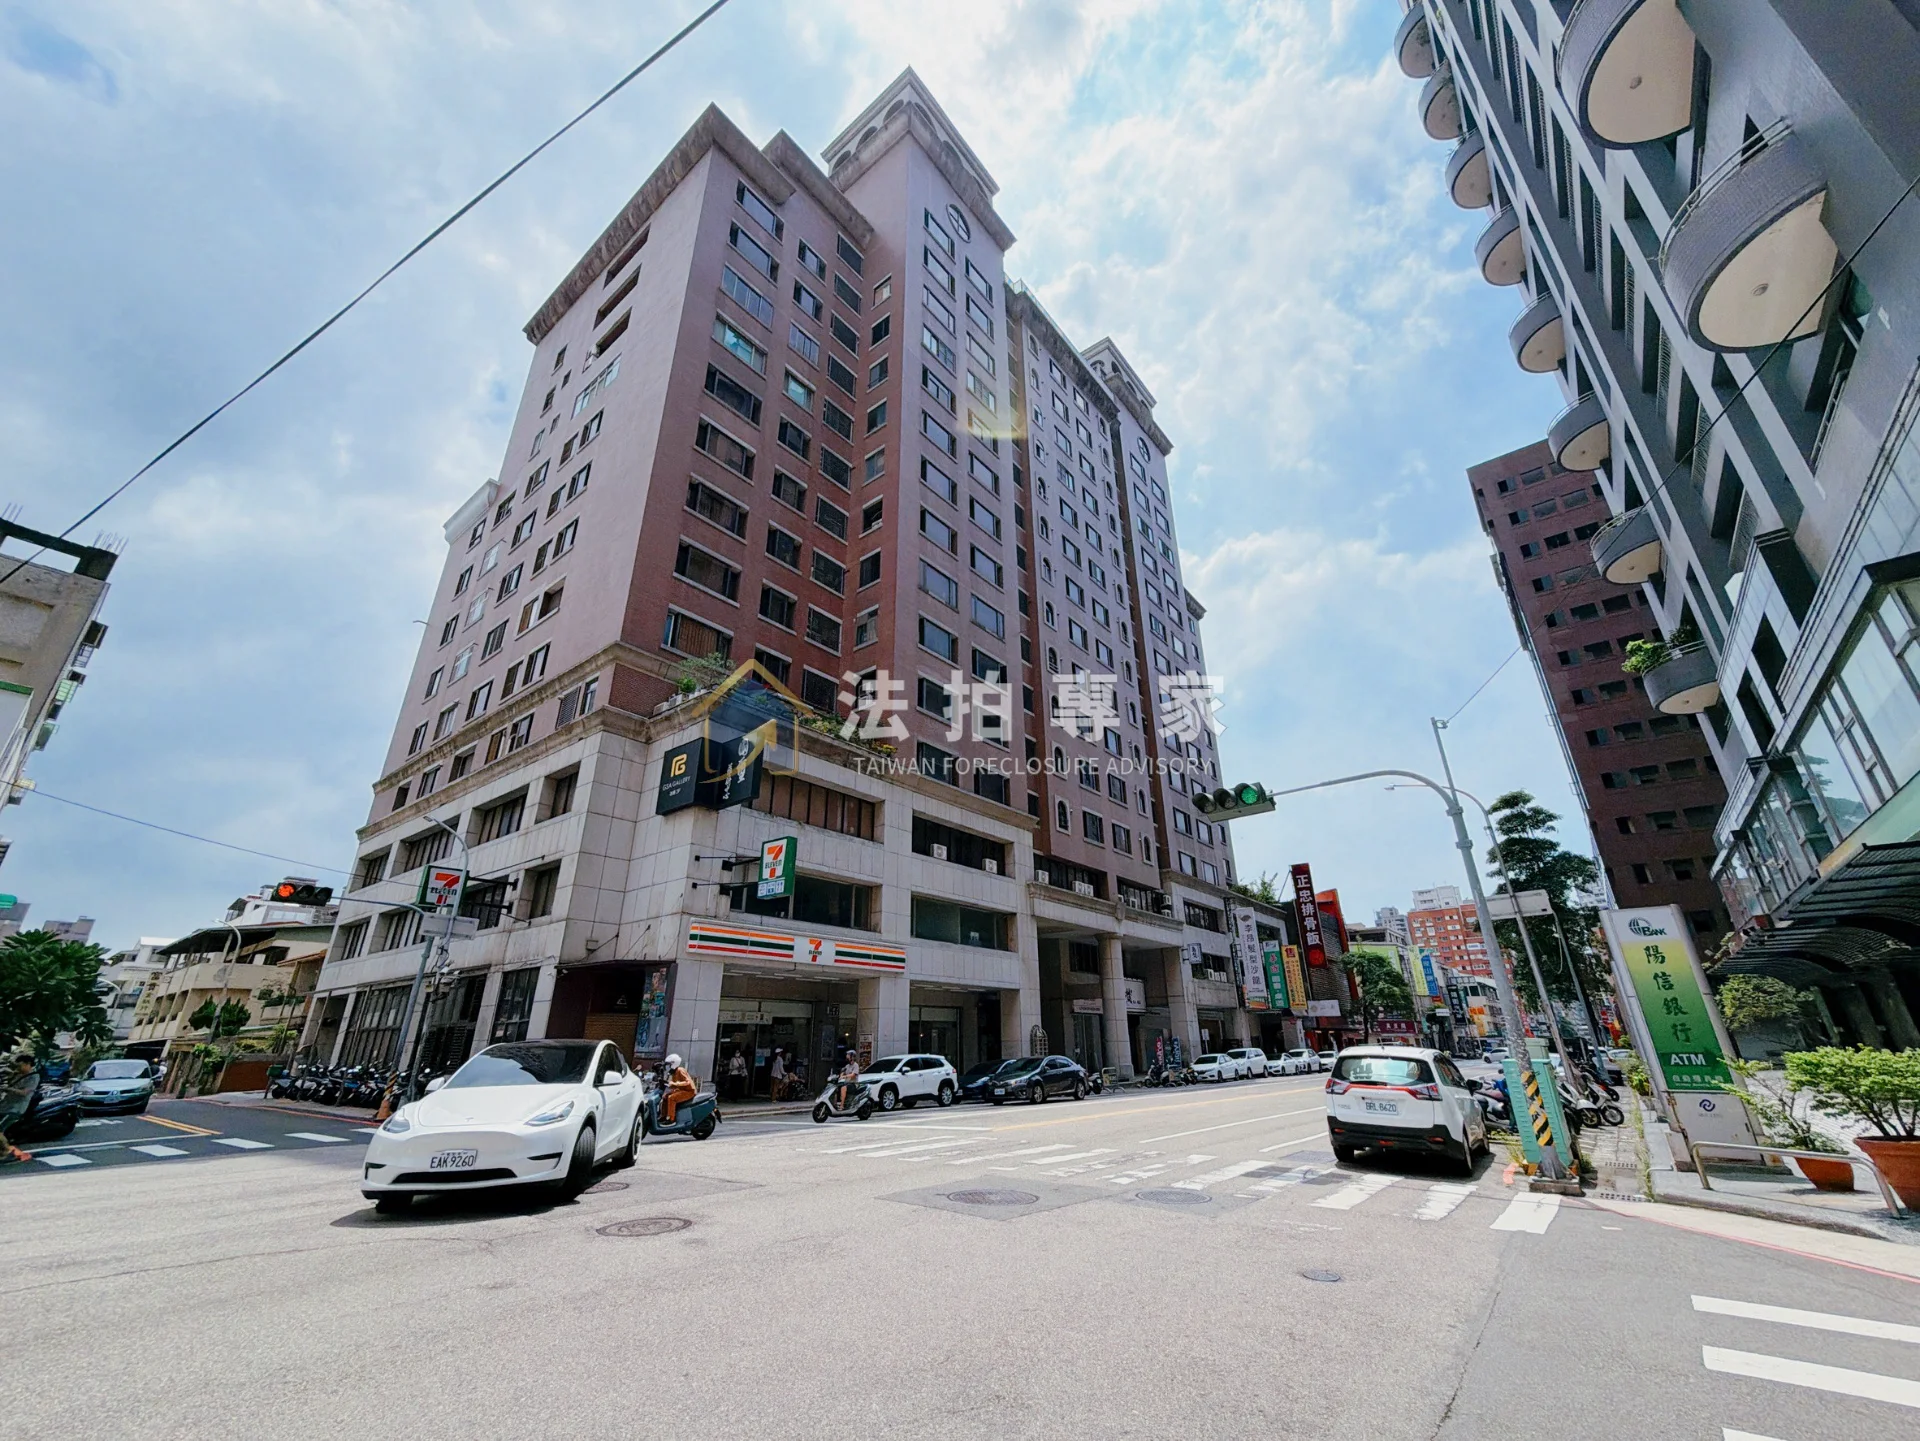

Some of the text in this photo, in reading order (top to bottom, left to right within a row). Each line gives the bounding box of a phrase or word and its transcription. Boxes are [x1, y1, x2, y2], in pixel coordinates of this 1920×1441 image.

[1295, 874, 1323, 946] 正忠排骨飯
[1642, 926, 1667, 937] BANK
[1643, 944, 1693, 1044] 陽信銀行
[1670, 1053, 1707, 1066] ATM
